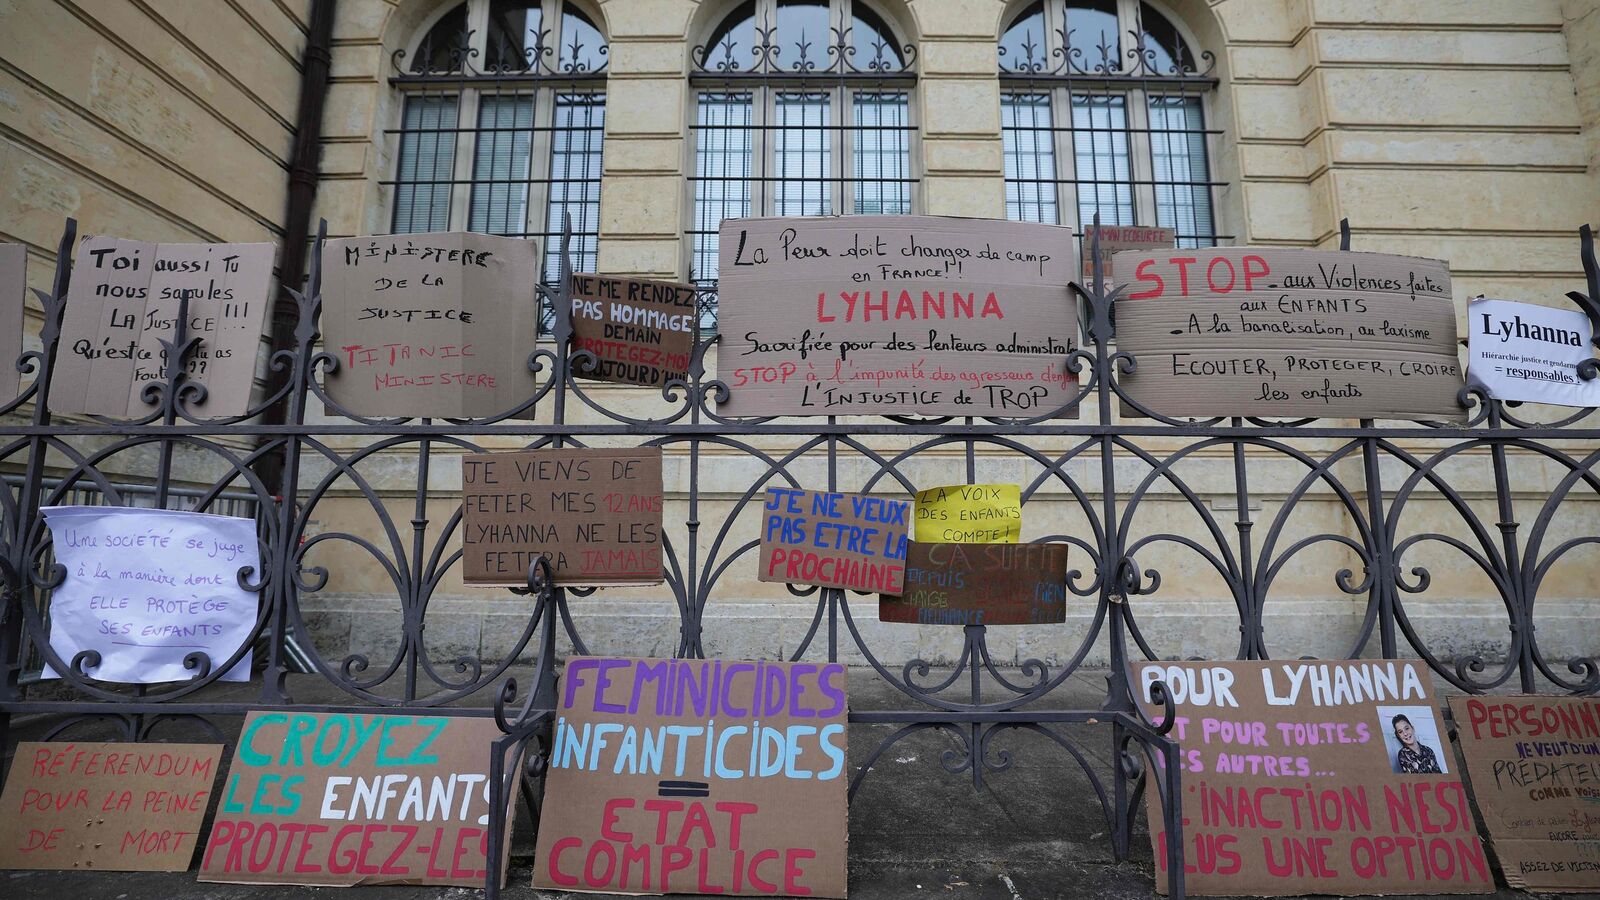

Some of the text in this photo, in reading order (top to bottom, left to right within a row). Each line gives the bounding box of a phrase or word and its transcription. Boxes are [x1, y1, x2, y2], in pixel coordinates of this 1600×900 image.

[1086, 228, 1120, 241] MMAN
[90, 248, 139, 271] Toi
[154, 248, 211, 272] aussi
[345, 241, 493, 267] MINISTERE
[734, 230, 769, 266] La
[779, 227, 832, 261] Peur
[840, 233, 888, 259] doit
[901, 235, 971, 266] changer
[976, 243, 1001, 260] de
[1006, 249, 1051, 277] camp
[375, 274, 444, 291] DE LA
[851, 272, 871, 283] en
[1128, 256, 1270, 299] STOP
[1283, 275, 1315, 288] aux
[1318, 263, 1401, 290] Violences
[1406, 271, 1443, 301] faites
[96, 284, 147, 298] nous
[573, 276, 695, 308] NE ME RENDEZ
[572, 299, 693, 333] PAS HOMMAGE
[816, 289, 1004, 324] LYHANNA
[1240, 295, 1367, 314] aux ENFANTS
[110, 308, 136, 330] LA
[1188, 313, 1202, 334] A
[1208, 313, 1231, 334] la
[1358, 326, 1375, 336] au
[1379, 320, 1432, 340] laxisme
[1482, 313, 1582, 347] Lyhanna
[604, 323, 662, 345] DEMAIN
[741, 329, 832, 360] Sacrifiée
[839, 340, 876, 361] pour
[883, 332, 916, 351] des
[923, 329, 987, 351] lenteurs
[216, 349, 232, 358] as
[342, 343, 476, 369] TITANIC
[1482, 351, 1520, 361] Hiérarchie
[1521, 355, 1541, 364] justice
[1549, 359, 1578, 369] gendarm
[135, 367, 168, 382] Fout
[733, 362, 796, 386] STOP
[806, 362, 818, 381] à
[930, 366, 955, 382] des
[960, 370, 1034, 389] agresseurs
[1400, 361, 1456, 376] CROIRE
[1506, 367, 1574, 382] responsables
[374, 373, 497, 391] MINISTERE
[1254, 378, 1362, 404] les enfants
[801, 382, 1048, 410] L'INJUSTICE de TROP
[464, 458, 641, 484] JE VIENS DE
[466, 491, 662, 514] FETER MES 12 ANS
[766, 488, 908, 526] JE NE VEUX
[921, 487, 1001, 504] LA VOIX
[918, 506, 1021, 521] DES ENFANTS
[465, 523, 657, 544] LYHANNA NE LES
[767, 515, 908, 561] PAS ETRE LA
[943, 528, 1000, 543] COMPTE
[186, 539, 204, 549] se
[207, 538, 245, 561] juge
[580, 548, 660, 573] JAMAIS
[78, 562, 223, 587] à la manière dont
[768, 548, 904, 593] PROCHAINE
[90, 594, 230, 615] ELLE PROTÈGE
[99, 620, 224, 638] SES ENFANTS
[564, 658, 845, 718] FEMINICIDES
[1141, 662, 1426, 708] POUR LYHANNA
[1202, 717, 1269, 747] POUR
[1466, 699, 1600, 740] PERSONN
[239, 713, 449, 769] CROYEZ
[552, 717, 845, 780] INFANTICIDES
[1516, 742, 1535, 758] NE
[1536, 742, 1568, 757] VEUT
[32, 744, 212, 781] RÉFERENDUM
[20, 789, 209, 815] POUR LA PEINE
[223, 773, 306, 816] LES
[1529, 786, 1571, 801] COMME
[1384, 781, 1471, 834] N'EST
[601, 798, 758, 851] ETAT
[1549, 831, 1578, 841] ENCORE
[20, 828, 195, 856] DE MORT
[549, 837, 817, 896] COMPLICE
[1262, 832, 1489, 884] UNE OPTION
[1520, 861, 1550, 875] ASSEZ
[1551, 861, 1566, 872] DE
